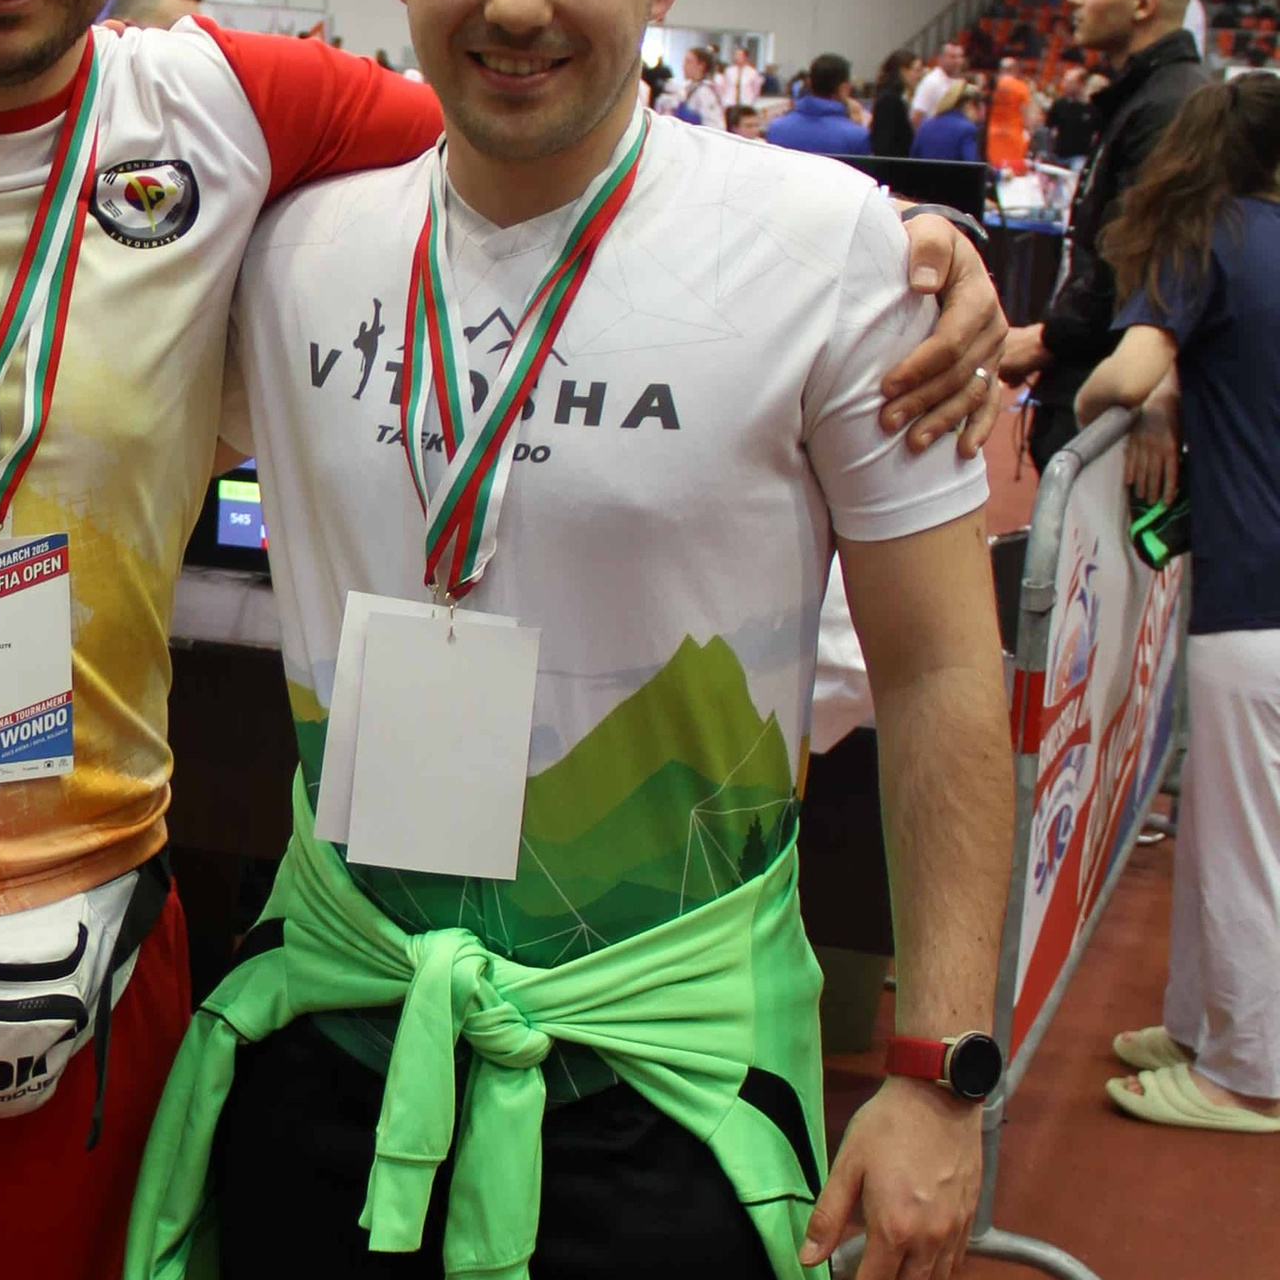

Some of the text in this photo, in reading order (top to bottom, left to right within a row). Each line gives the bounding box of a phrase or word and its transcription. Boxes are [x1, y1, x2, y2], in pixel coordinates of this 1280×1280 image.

[110, 230, 179, 248] FAVOURITE
[31, 541, 50, 556] 2025
[23, 555, 62, 582] OPEN
[16, 693, 68, 722] TOURNAMENT
